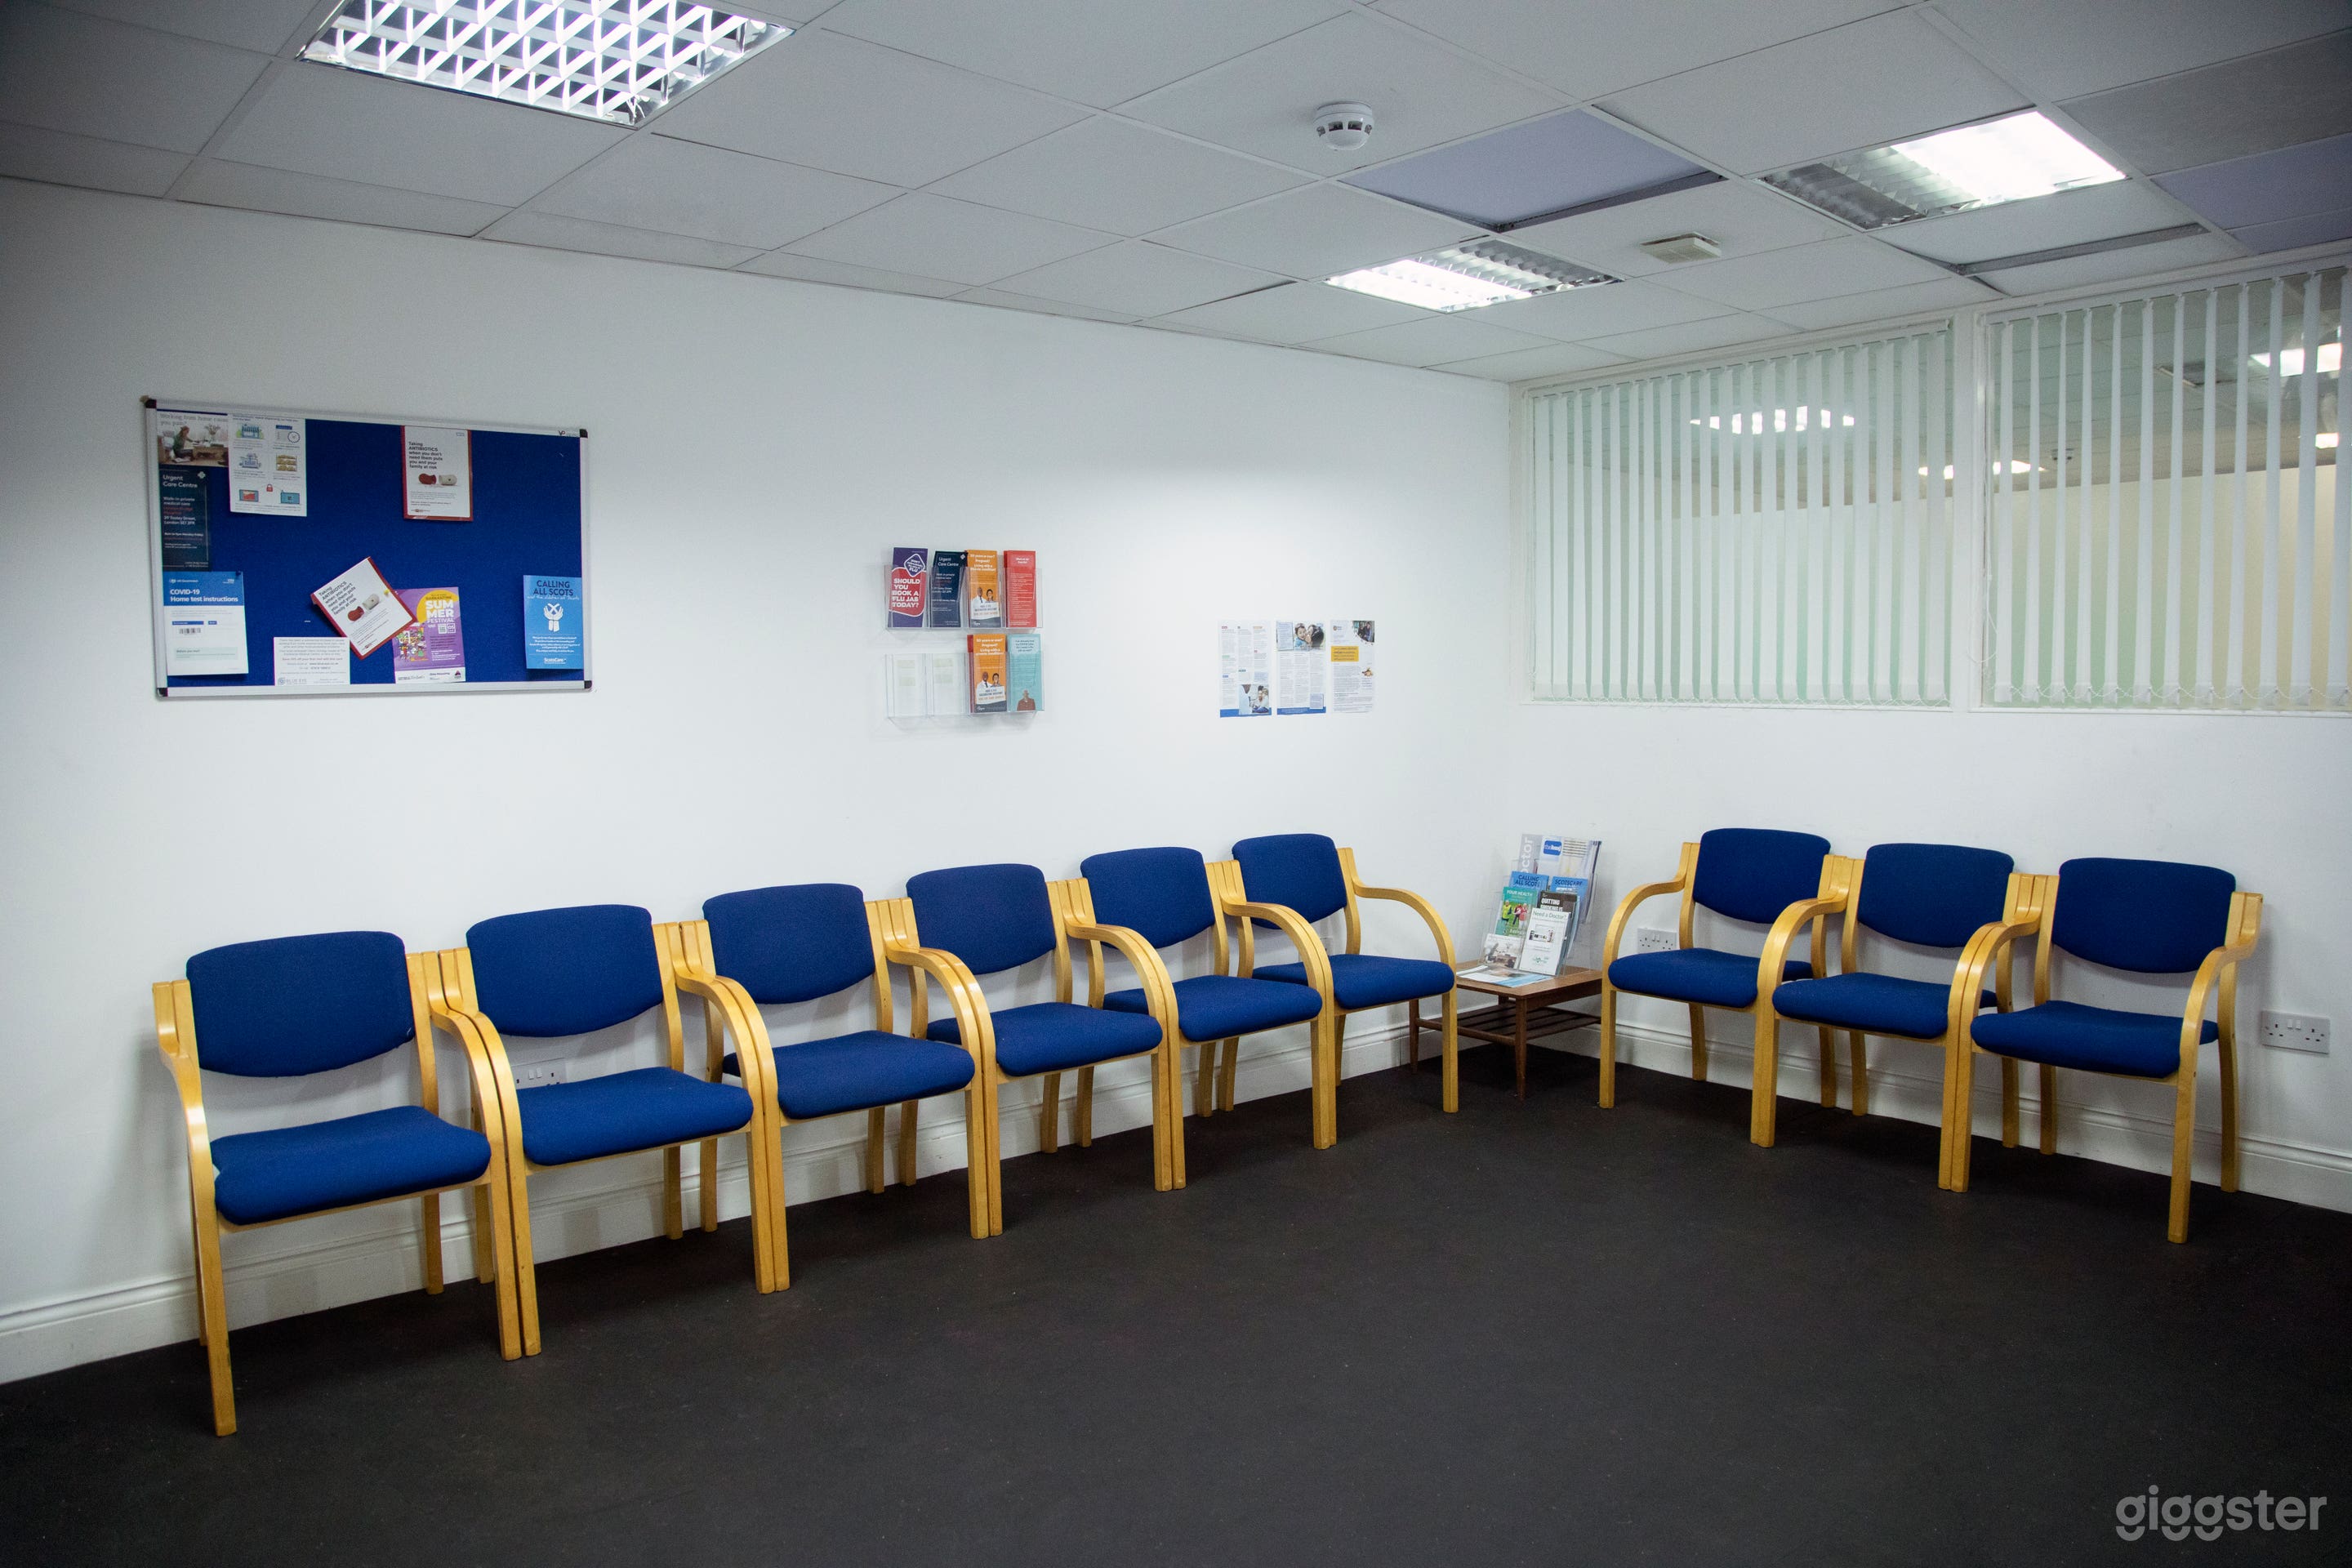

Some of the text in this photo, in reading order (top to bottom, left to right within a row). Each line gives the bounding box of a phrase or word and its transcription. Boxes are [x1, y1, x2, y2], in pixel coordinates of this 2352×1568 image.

[537, 580, 570, 588] CALLING
[318, 586, 332, 596] Taking
[323, 581, 347, 600] ANTIBIOTICS
[549, 588, 574, 596] SCOTS
[425, 599, 454, 609] SUM
[426, 608, 455, 618] MER
